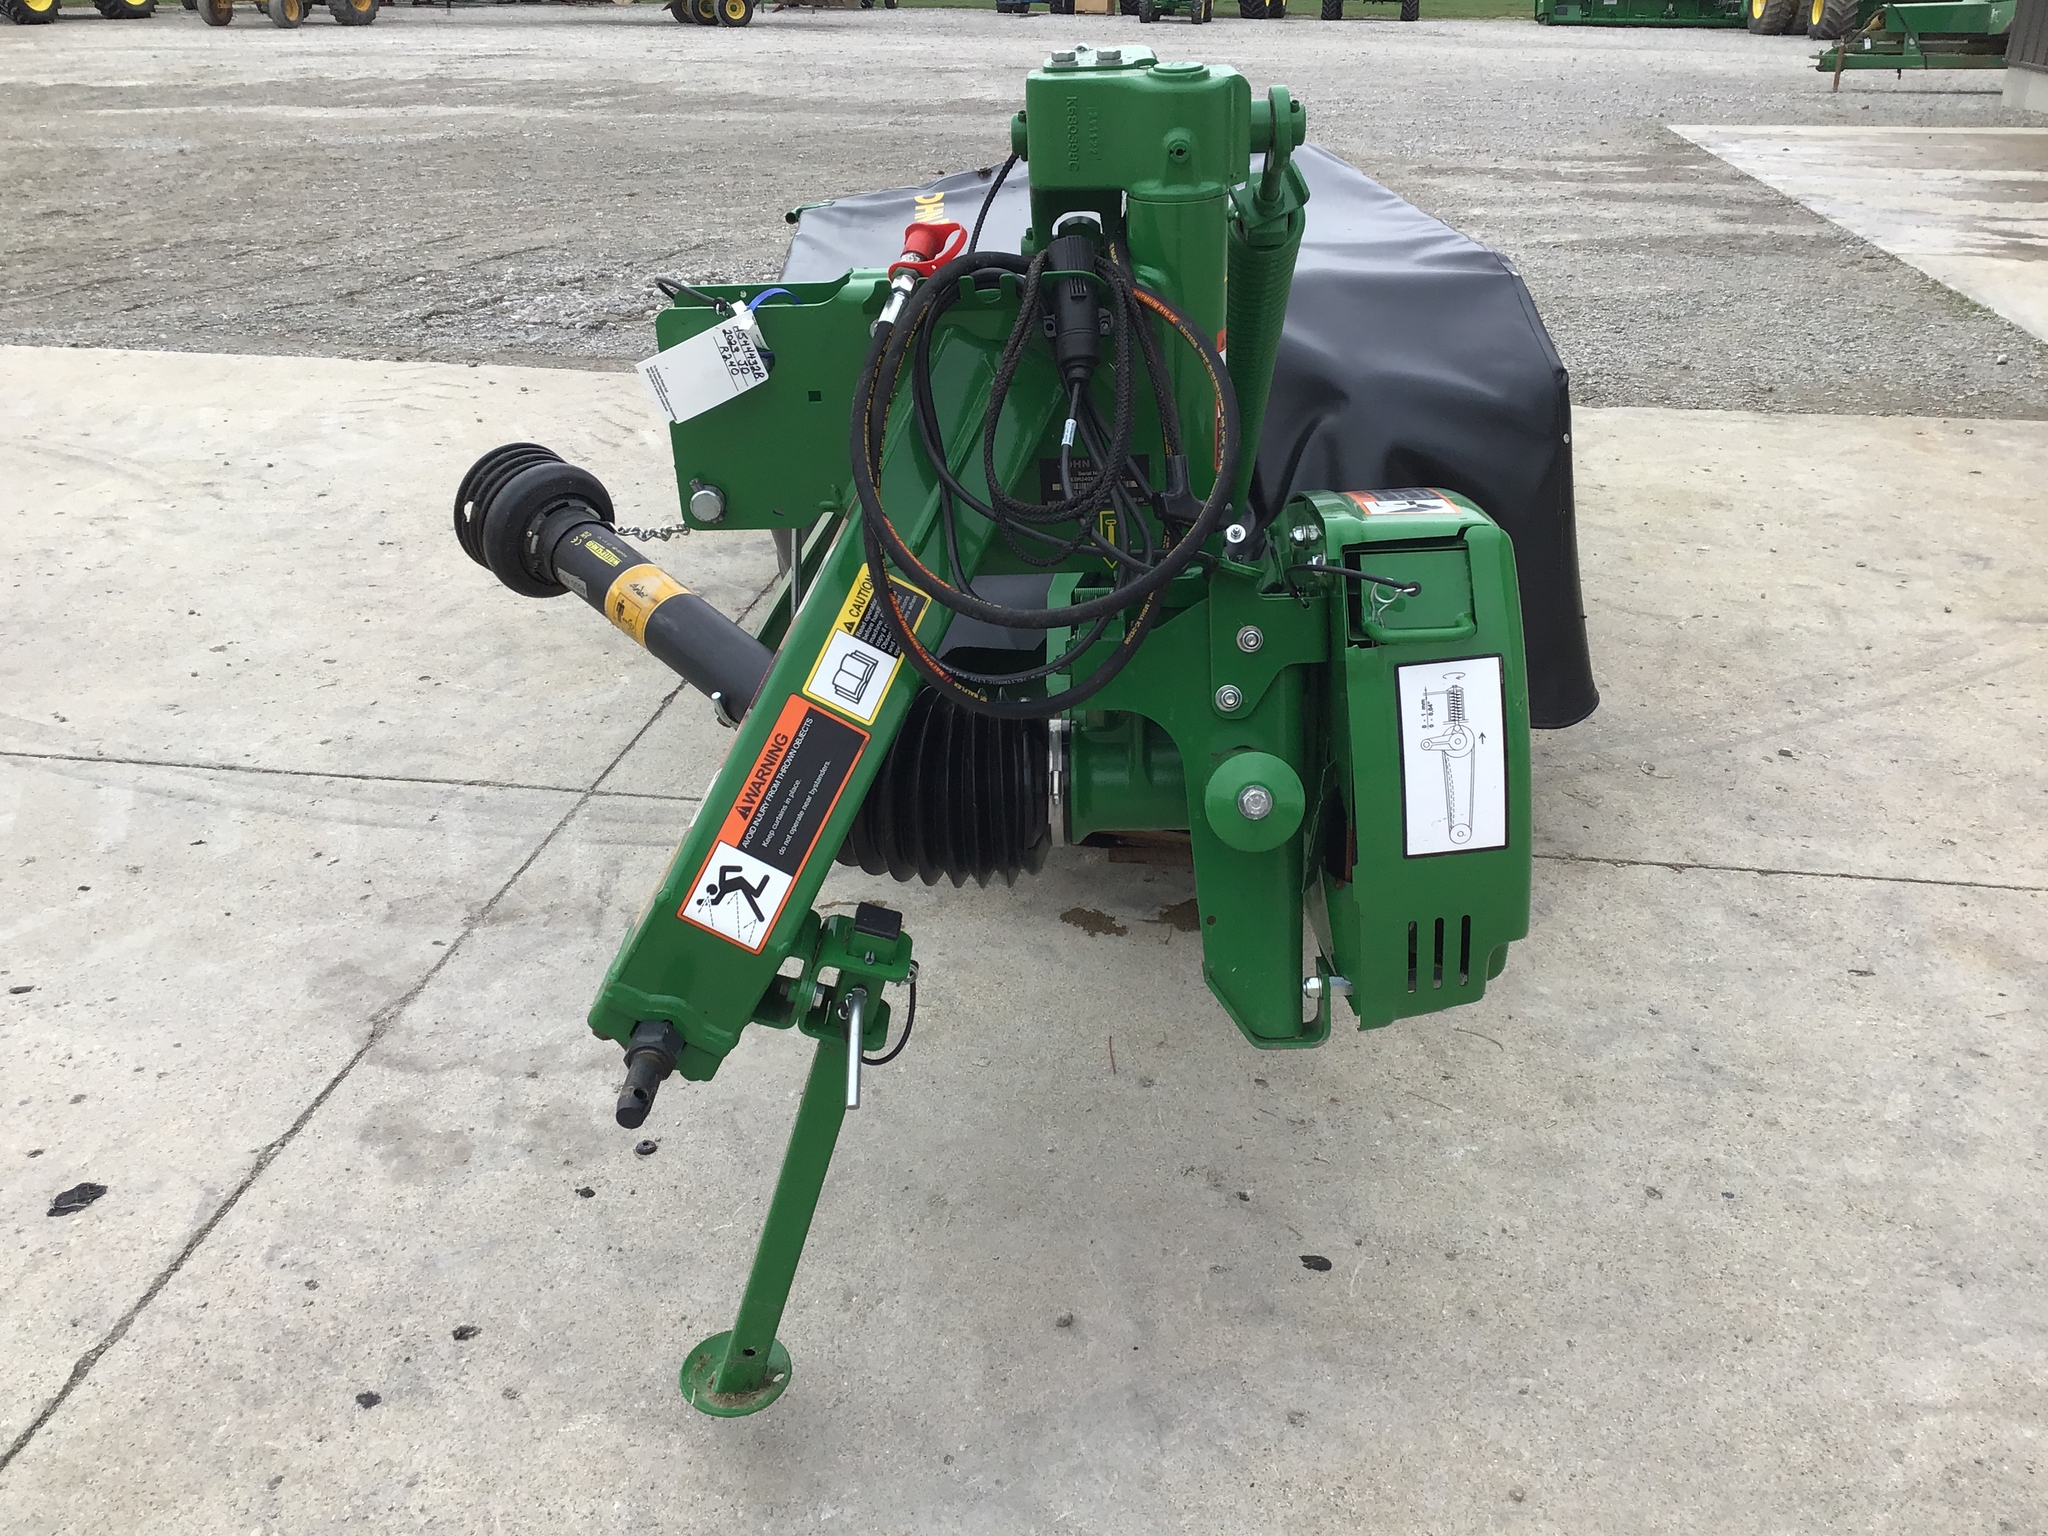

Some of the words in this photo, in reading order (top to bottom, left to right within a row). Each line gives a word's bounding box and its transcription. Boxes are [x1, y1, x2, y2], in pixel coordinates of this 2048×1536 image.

[721, 326, 741, 354] 2023
[717, 343, 740, 377] R240
[848, 573, 873, 618] CAUTION
[855, 621, 867, 637] Read
[862, 597, 879, 622] operator
[886, 640, 896, 652] and
[906, 594, 919, 610] when
[861, 621, 875, 640] before
[873, 632, 886, 647] copy
[741, 730, 789, 807] WARNING
[807, 758, 833, 795] bystanders.
[740, 825, 758, 848] AVOID
[751, 799, 771, 826] INJURY
[764, 778, 781, 801] FROM
[775, 748, 798, 779] THROWN
[791, 716, 814, 750] OBJECTS
[787, 777, 803, 798] place.
[783, 796, 792, 805] in
[800, 794, 813, 810] near
[769, 803, 789, 830] curtains
[787, 809, 806, 835] operate
[760, 828, 776, 848] Keep
[776, 844, 787, 855] do
[781, 833, 792, 846] not
